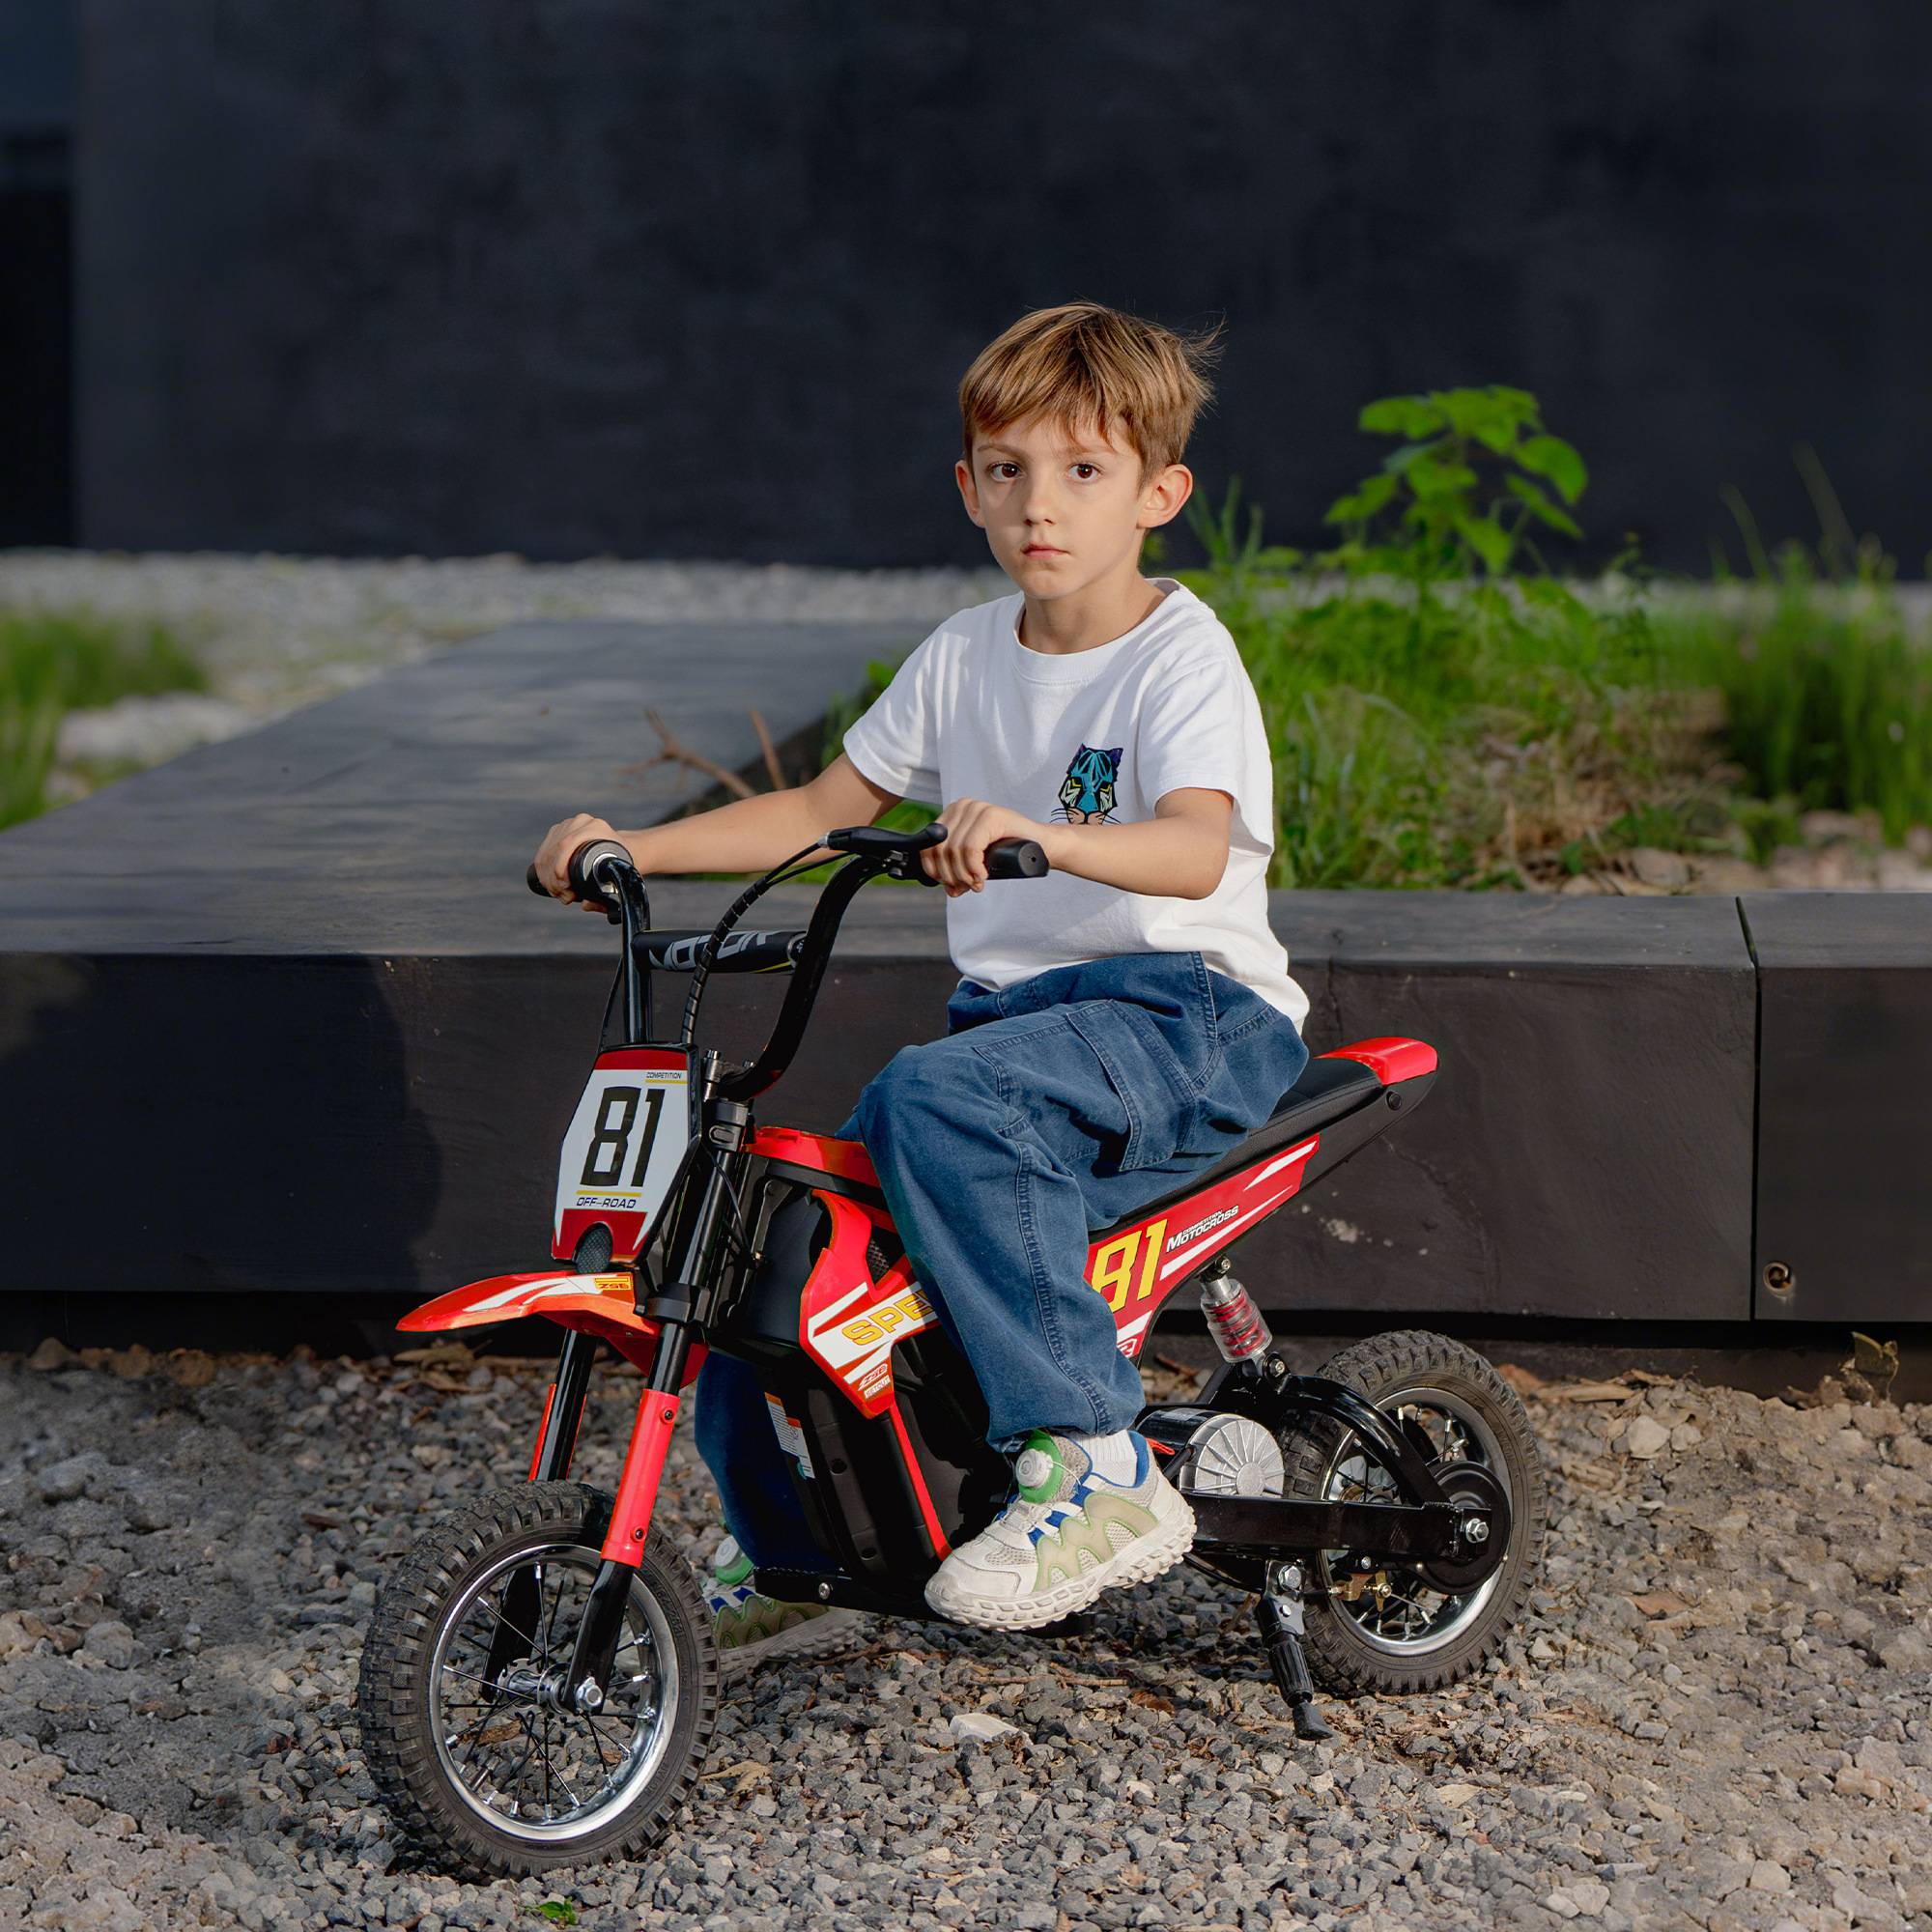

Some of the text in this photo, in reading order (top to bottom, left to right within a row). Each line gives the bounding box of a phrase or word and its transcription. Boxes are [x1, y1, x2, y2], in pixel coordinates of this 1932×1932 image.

[580, 1086, 666, 1187] 81
[576, 1197, 637, 1208] OFF-ROAD
[1181, 1208, 1223, 1236] COMPETITION
[1092, 1218, 1168, 1313] 81
